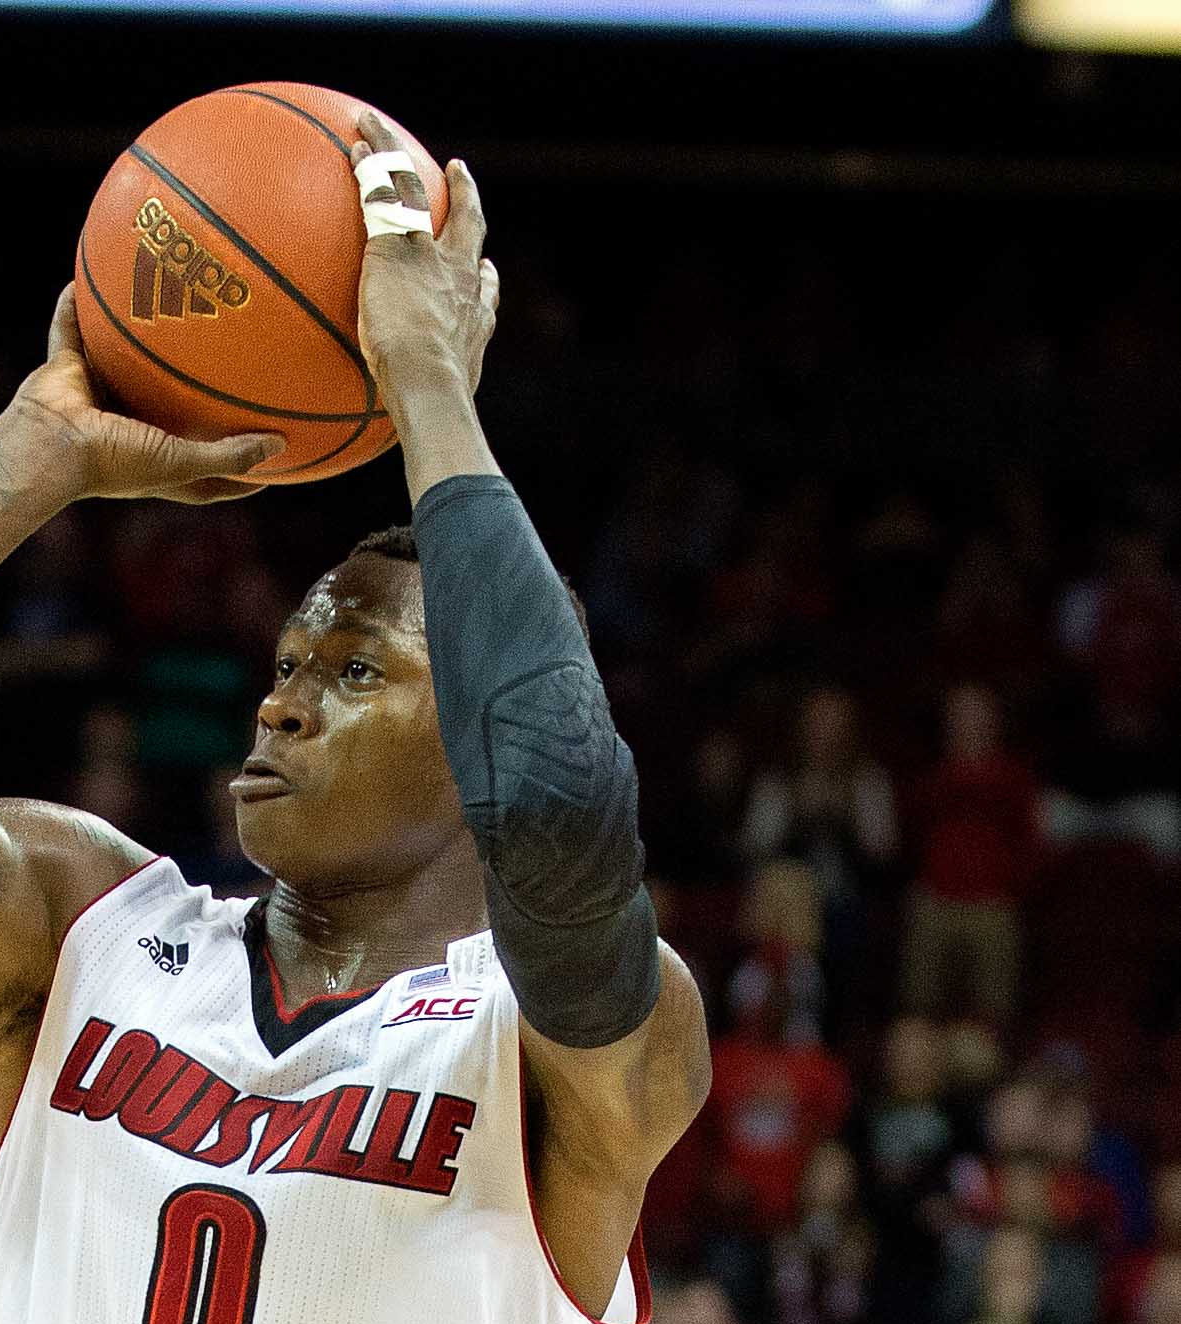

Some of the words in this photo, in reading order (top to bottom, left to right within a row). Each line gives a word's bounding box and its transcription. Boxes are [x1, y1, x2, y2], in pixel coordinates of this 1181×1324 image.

[136, 196, 250, 310] adidas
[390, 998, 482, 1022] ACC
[50, 1016, 476, 1196] LOUISVILLE
